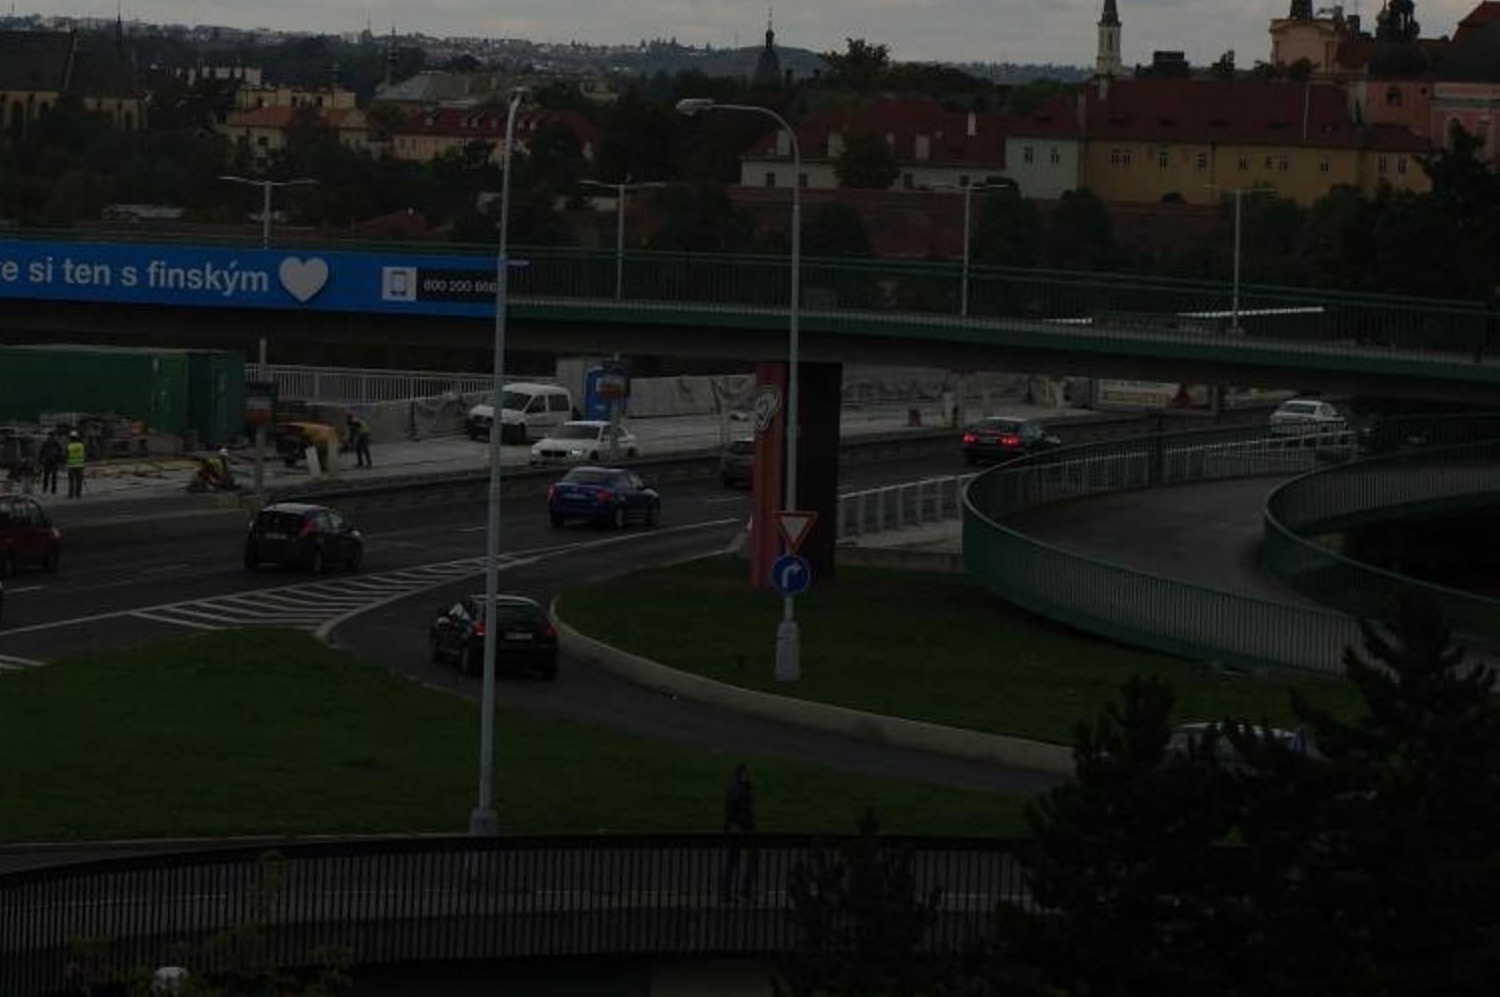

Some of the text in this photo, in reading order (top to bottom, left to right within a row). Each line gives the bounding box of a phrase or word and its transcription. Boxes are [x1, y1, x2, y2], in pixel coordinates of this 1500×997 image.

[28, 256, 54, 284] si
[63, 257, 111, 285] ten
[120, 266, 138, 287] s
[148, 259, 269, 296] finským
